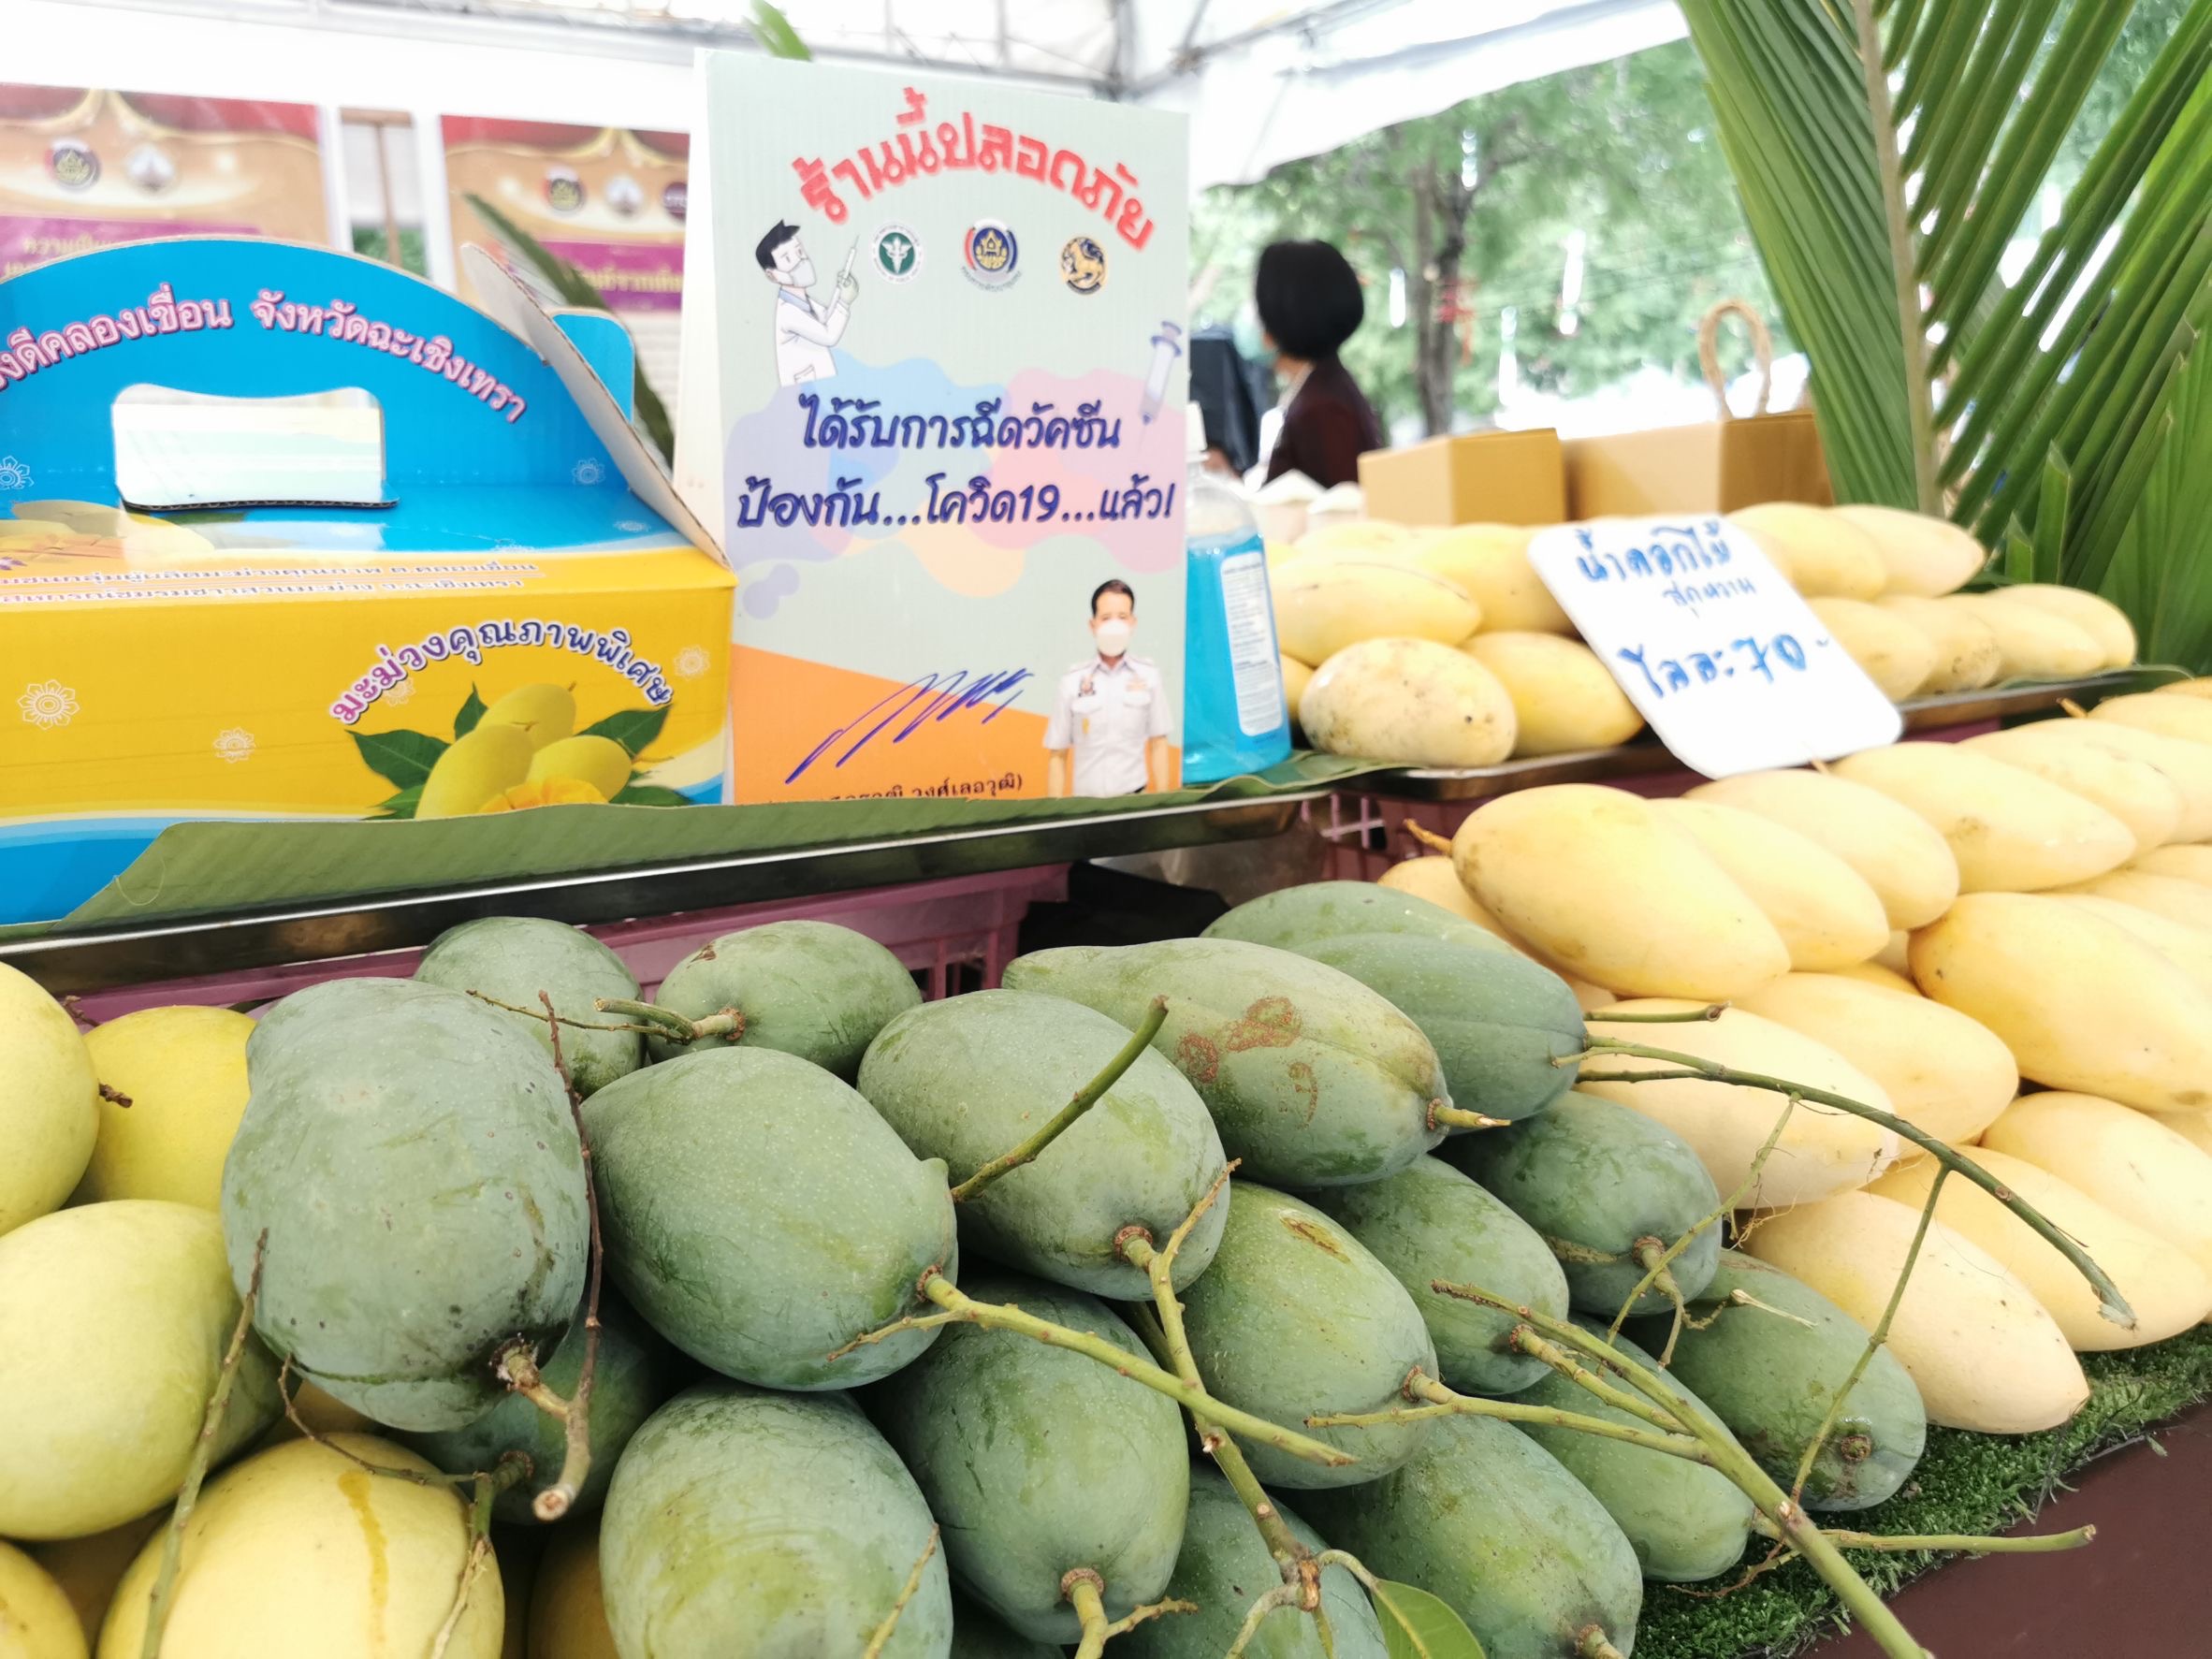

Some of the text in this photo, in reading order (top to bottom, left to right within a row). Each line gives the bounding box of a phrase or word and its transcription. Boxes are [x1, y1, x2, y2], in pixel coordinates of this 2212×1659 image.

[792, 86, 1157, 253] ร้านนี้ปลอดภัย
[0, 282, 527, 424] งดีคลองเขื่อน จังหวัดฉะเชิงเทรา
[797, 393, 1122, 450] ได้รับการฉีดวัคซีน
[328, 618, 674, 725] มะม่วงคุณภาพพิเศษ
